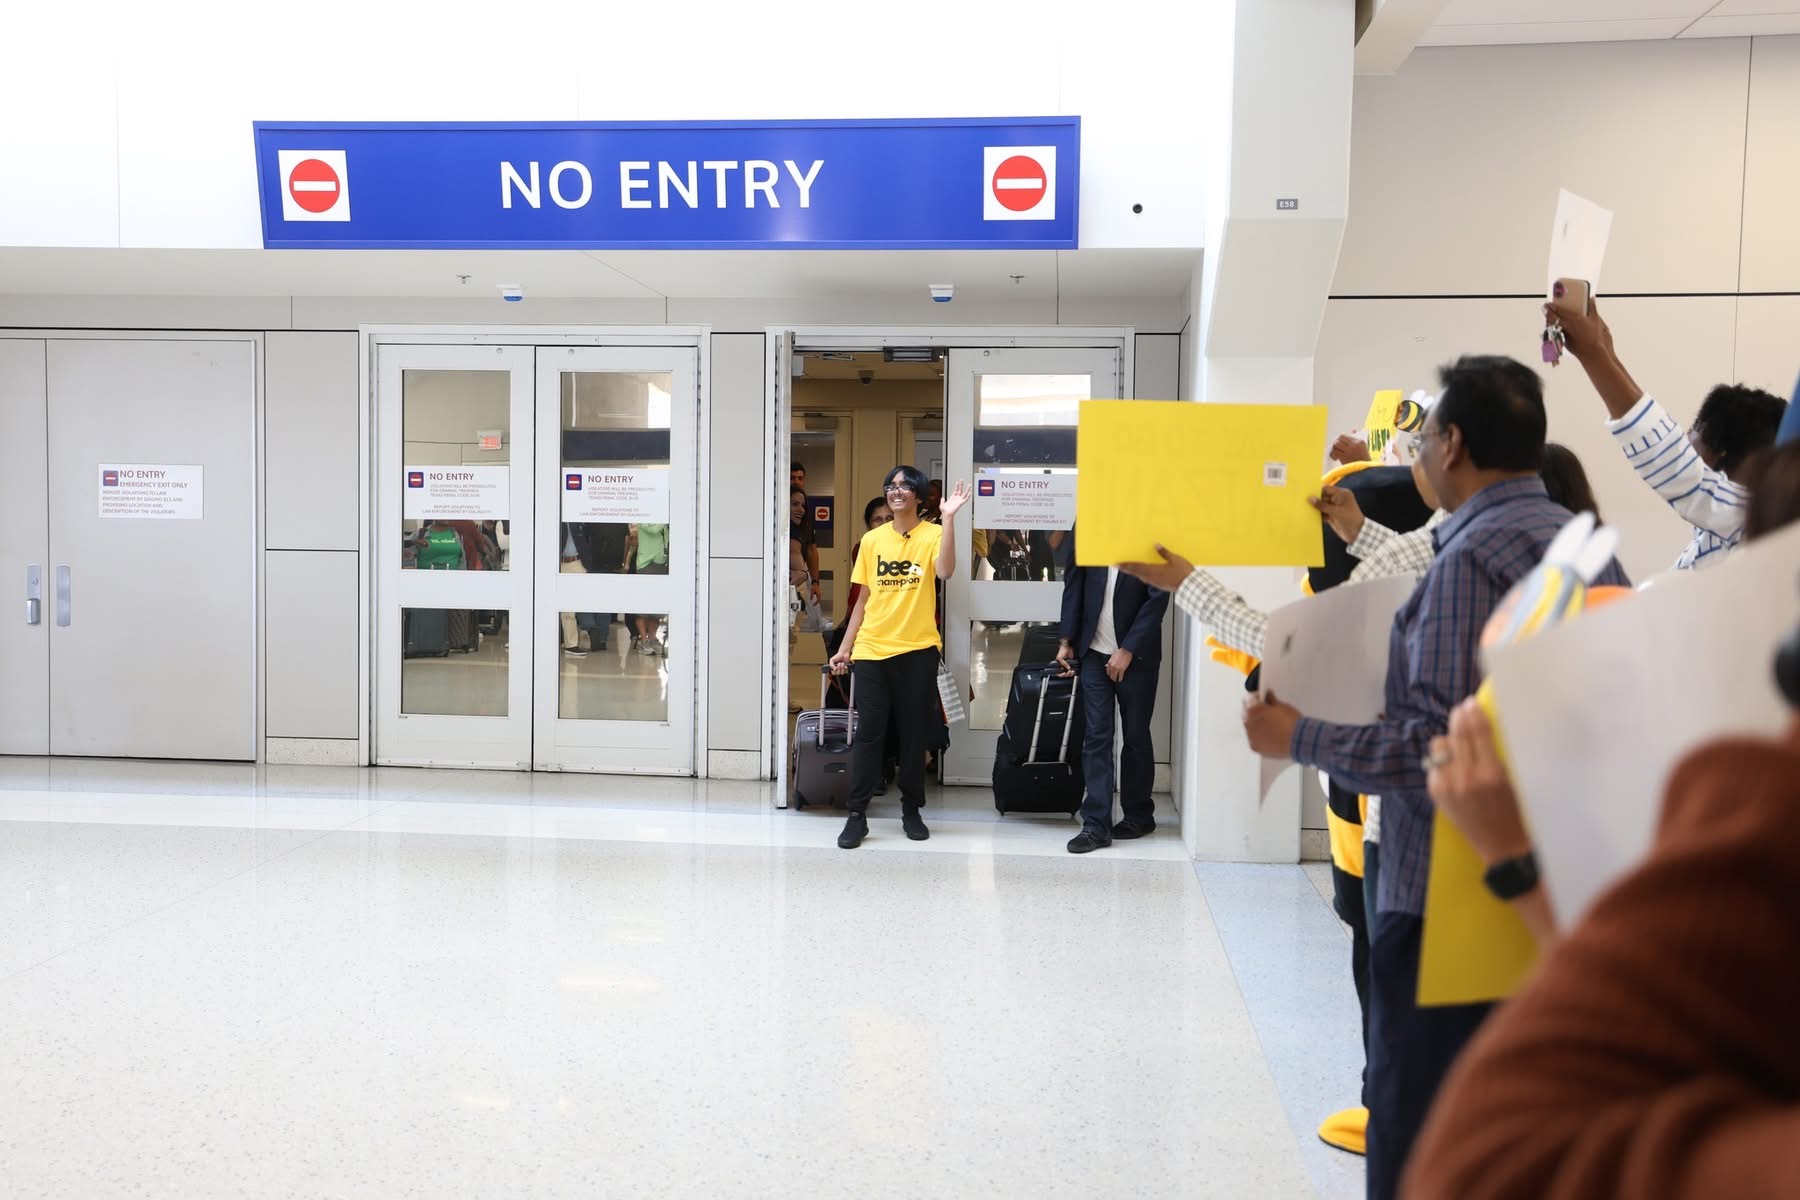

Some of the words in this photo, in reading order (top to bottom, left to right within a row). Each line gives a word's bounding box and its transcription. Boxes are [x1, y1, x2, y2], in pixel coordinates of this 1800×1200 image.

[500, 160, 593, 209] NO
[619, 160, 825, 209] ENTRY
[877, 555, 912, 576] bee
